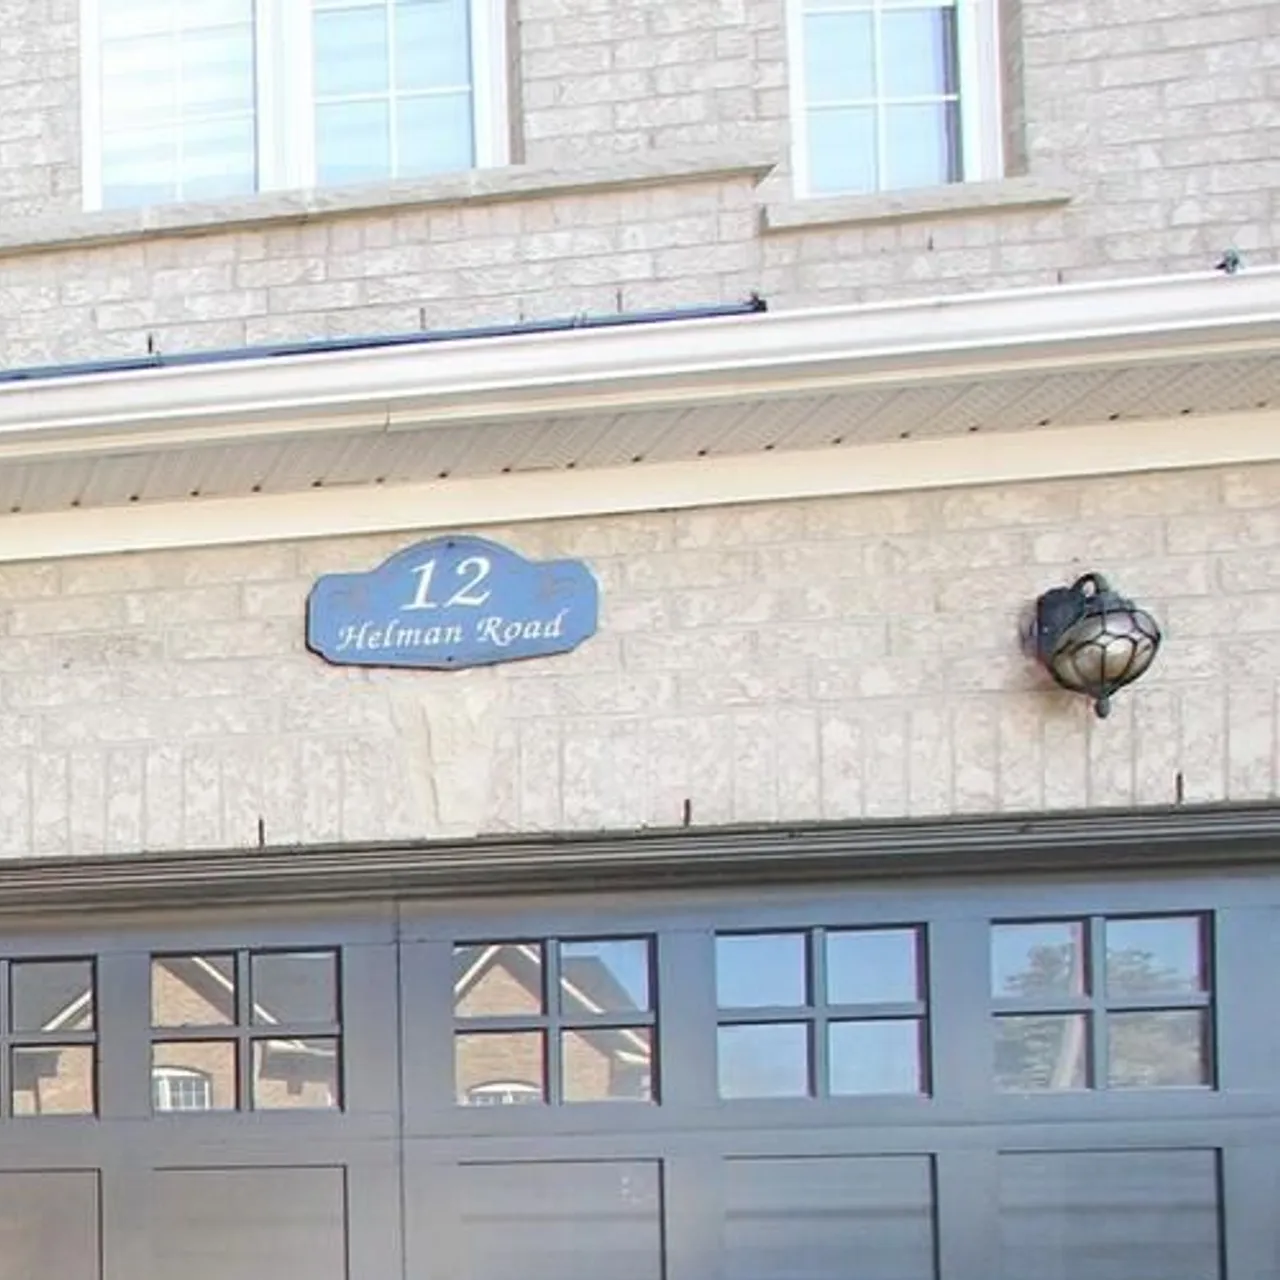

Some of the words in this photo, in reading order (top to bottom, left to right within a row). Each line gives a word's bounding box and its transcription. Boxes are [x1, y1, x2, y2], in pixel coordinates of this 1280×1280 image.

[398, 555, 494, 612] 12
[335, 618, 463, 651] Helman
[475, 607, 570, 647] Road
